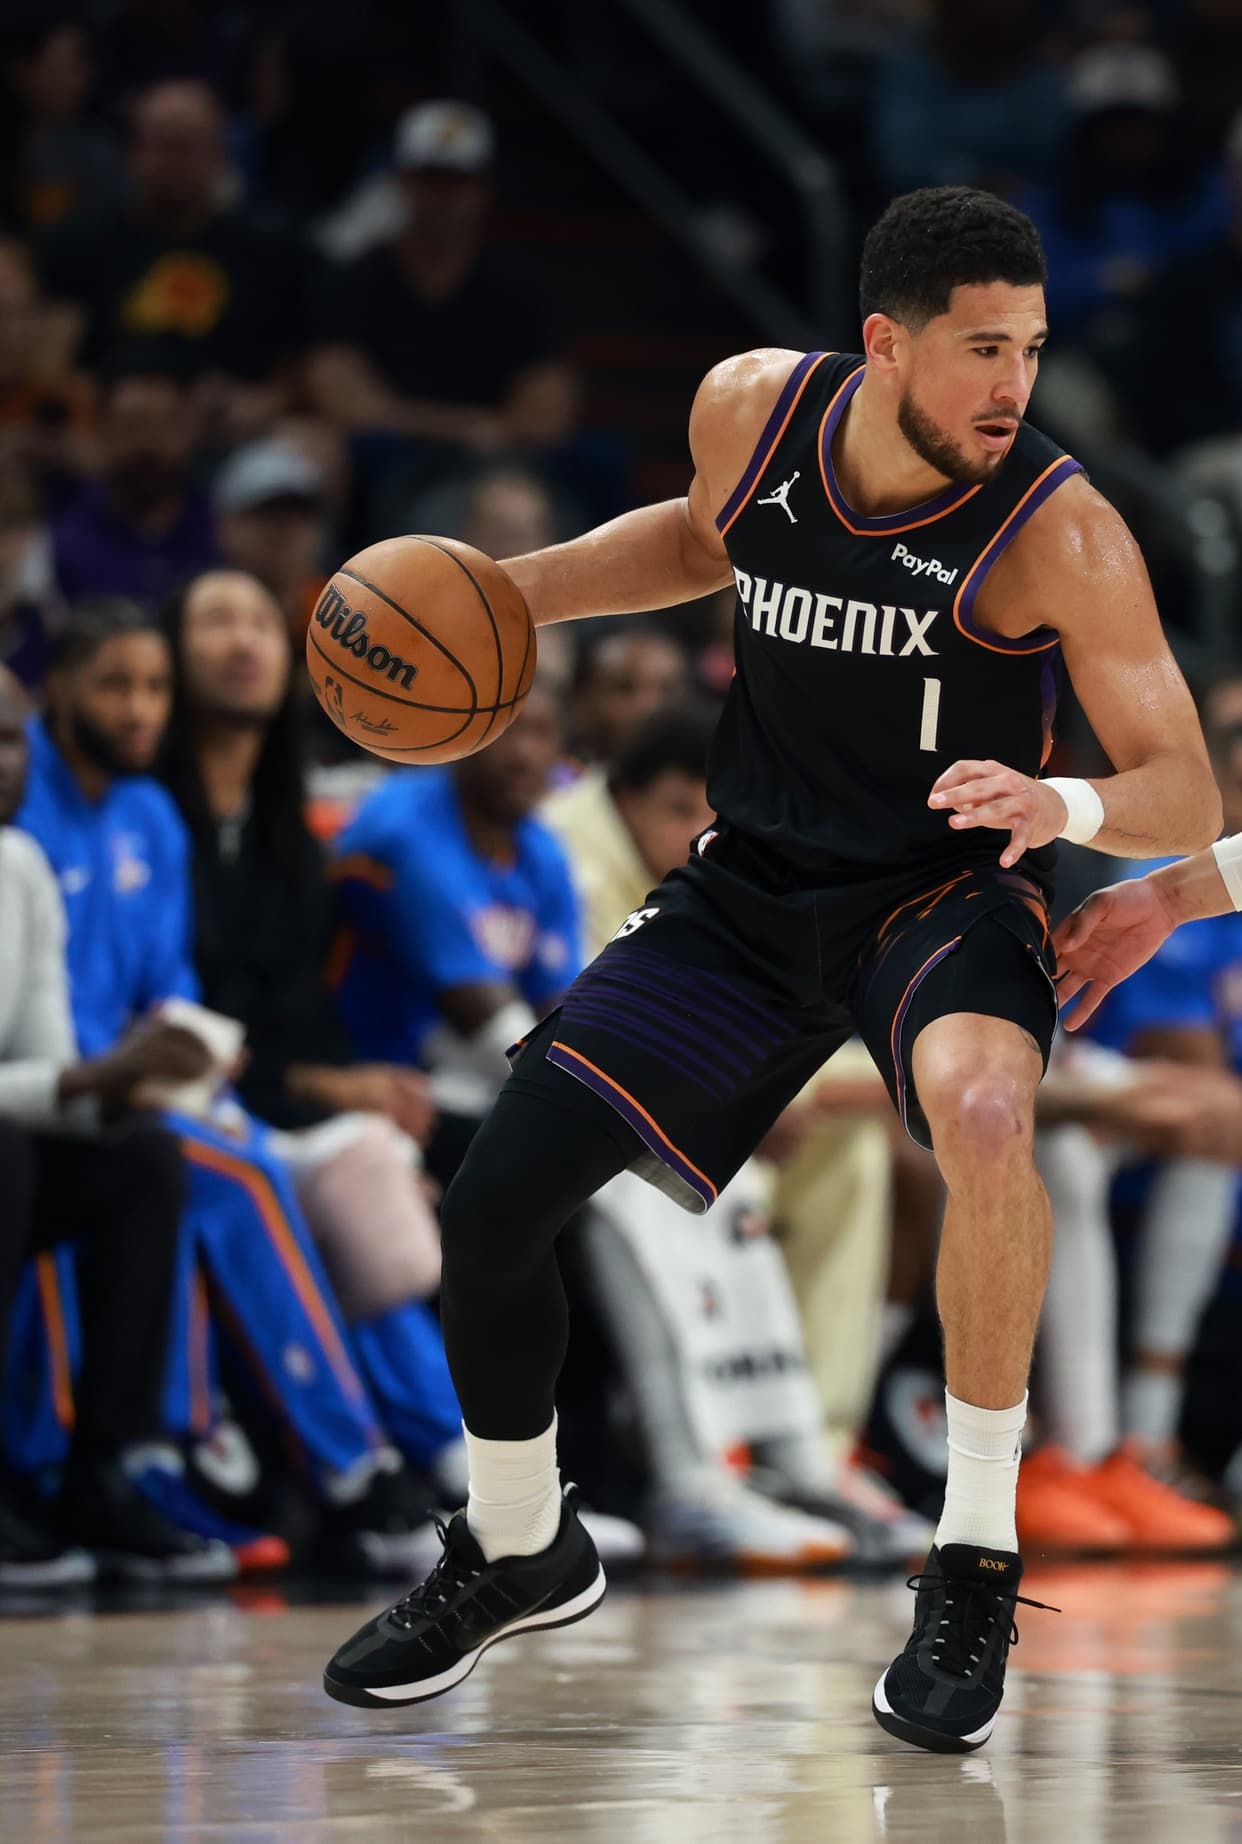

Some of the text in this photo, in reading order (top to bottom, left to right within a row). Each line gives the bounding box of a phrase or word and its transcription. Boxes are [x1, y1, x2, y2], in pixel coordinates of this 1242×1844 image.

[891, 543, 959, 585] PayPal
[315, 583, 419, 691] Wilson
[919, 677, 942, 752] 1
